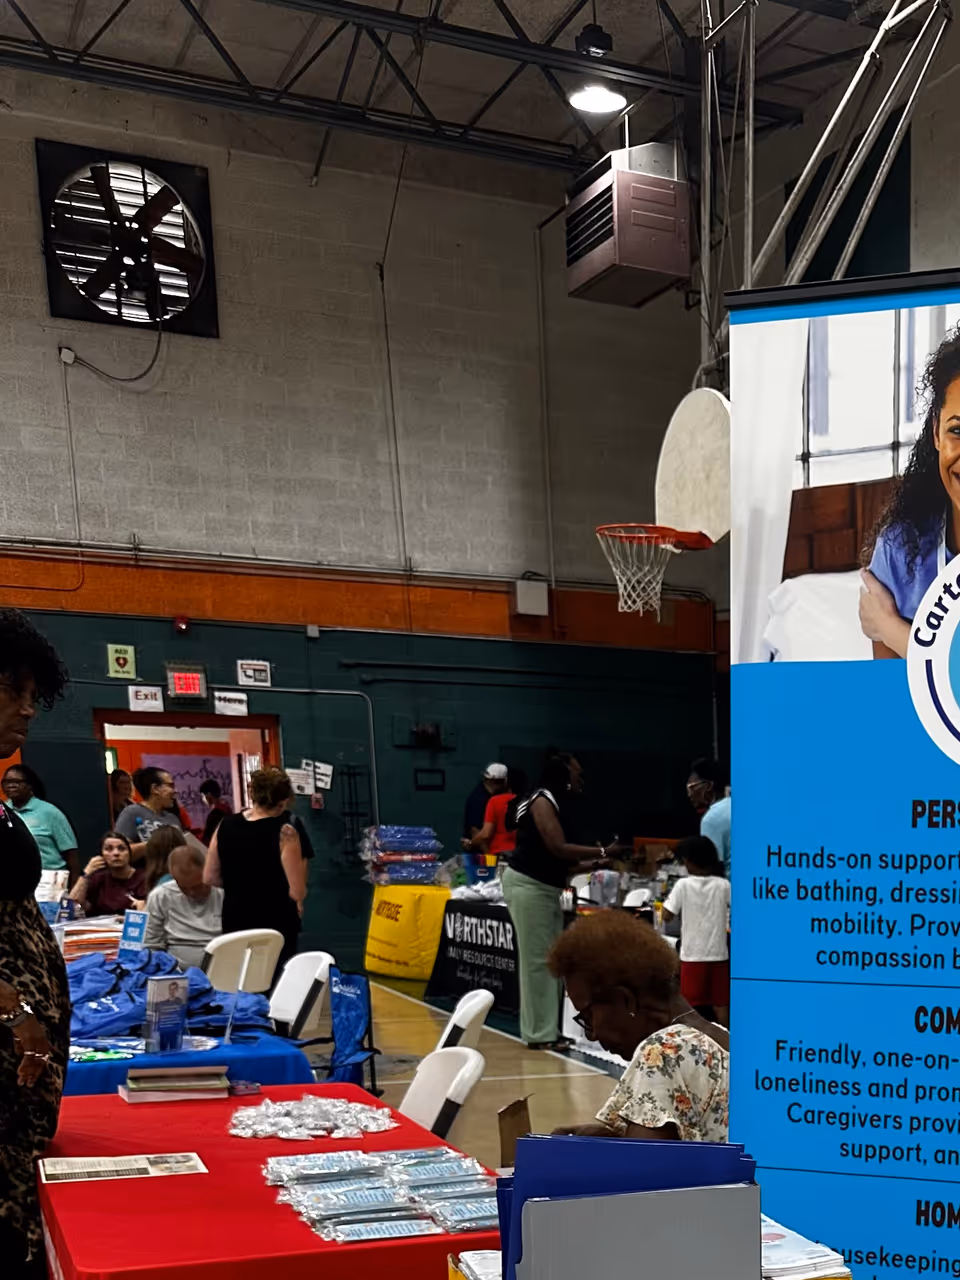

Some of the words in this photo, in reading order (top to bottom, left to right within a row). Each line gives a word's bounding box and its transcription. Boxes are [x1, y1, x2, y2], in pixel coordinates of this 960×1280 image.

[134, 690, 158, 701] Exit
[767, 845, 871, 869] Hands-on
[753, 877, 789, 899] like
[797, 879, 883, 906] bathing,
[811, 912, 902, 939] mobility.
[816, 946, 945, 970] compassion
[776, 1040, 866, 1069] Friendly,
[755, 1070, 861, 1096] loneliness
[868, 1078, 907, 1099] and
[787, 1102, 902, 1131] Caregivers
[840, 1143, 927, 1165] support,
